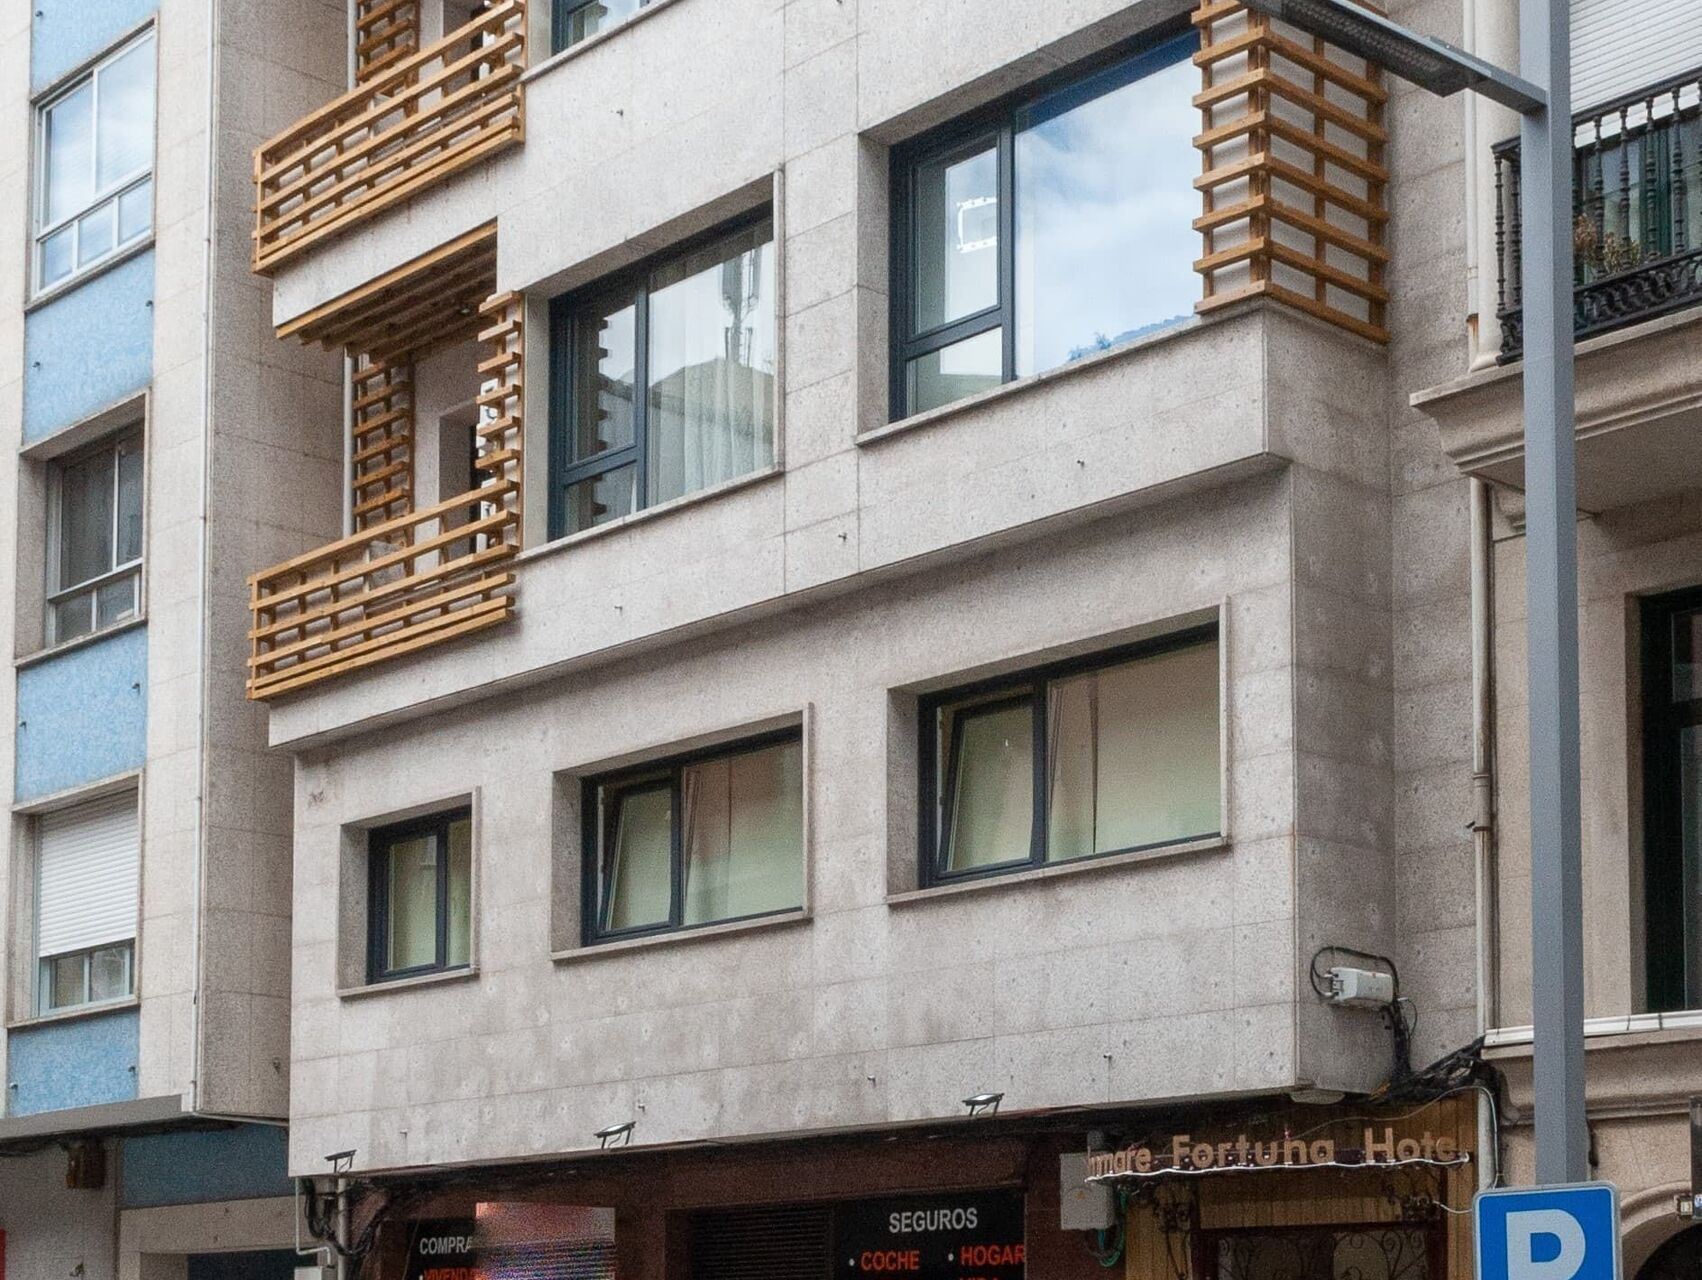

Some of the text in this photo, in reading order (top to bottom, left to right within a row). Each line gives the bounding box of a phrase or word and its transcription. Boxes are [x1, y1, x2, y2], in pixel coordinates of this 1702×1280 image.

[1172, 1134, 1334, 1168] Fortuna
[889, 1207, 978, 1233] SEGUROS
[860, 1250, 920, 1270] COCHE
[960, 1245, 1025, 1266] HOGAR
